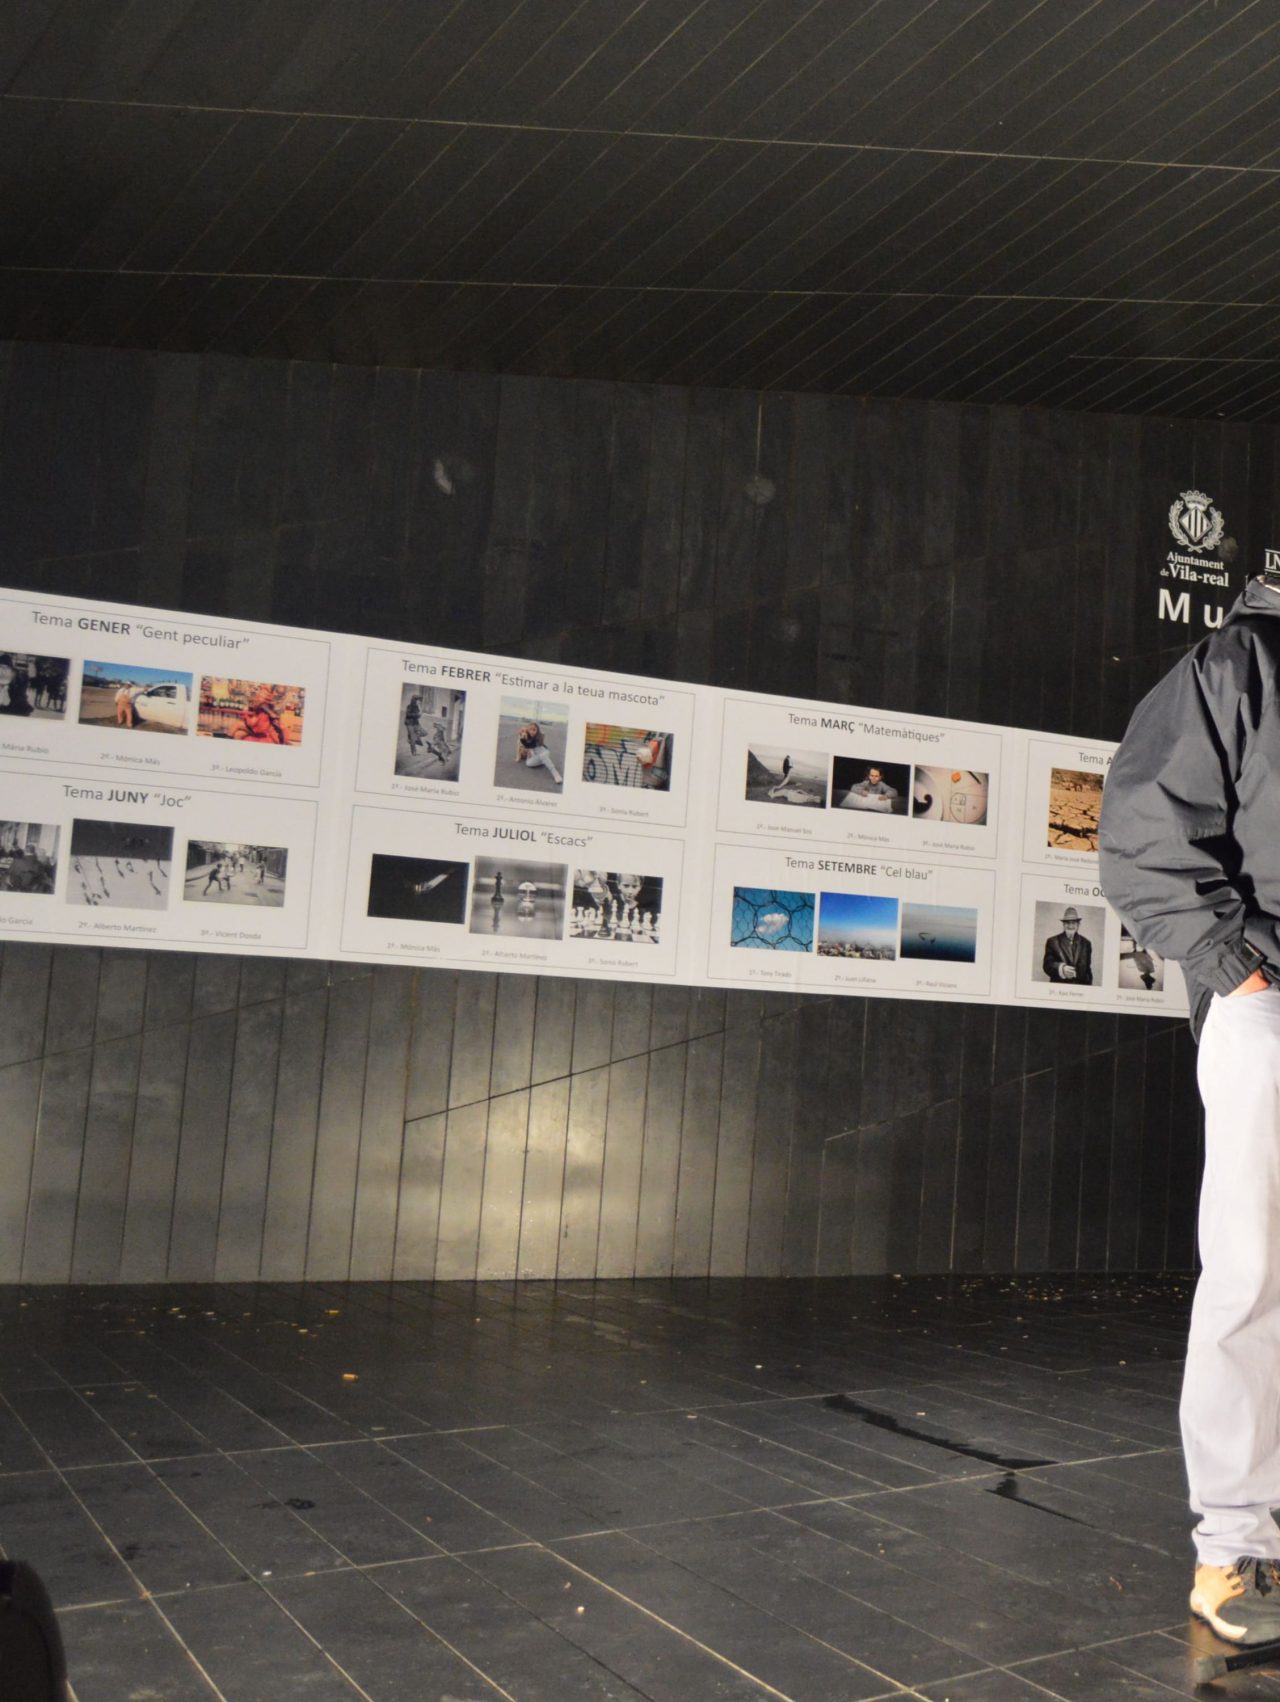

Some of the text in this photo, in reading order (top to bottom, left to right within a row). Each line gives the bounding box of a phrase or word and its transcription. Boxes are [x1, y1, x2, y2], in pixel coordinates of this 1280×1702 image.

[1167, 552, 1224, 570] Ajuntament
[1160, 568, 1169, 576] de
[1169, 563, 1229, 587] Vila-real
[32, 611, 250, 649] Tema GENER “Gent peculiar”
[402, 659, 665, 706] Tema FEBRER “Estimar a la teua mascota”
[788, 713, 817, 728] Tema
[820, 717, 855, 733] MARÇ
[1078, 752, 1104, 766] Tema
[63, 785, 191, 808] Tema JUNY “Joc”
[454, 822, 593, 848] Tema JULIOL “Escacs”
[785, 856, 933, 881] Tema SETEMBRE “Cel blau”
[1064, 884, 1090, 897] Tema
